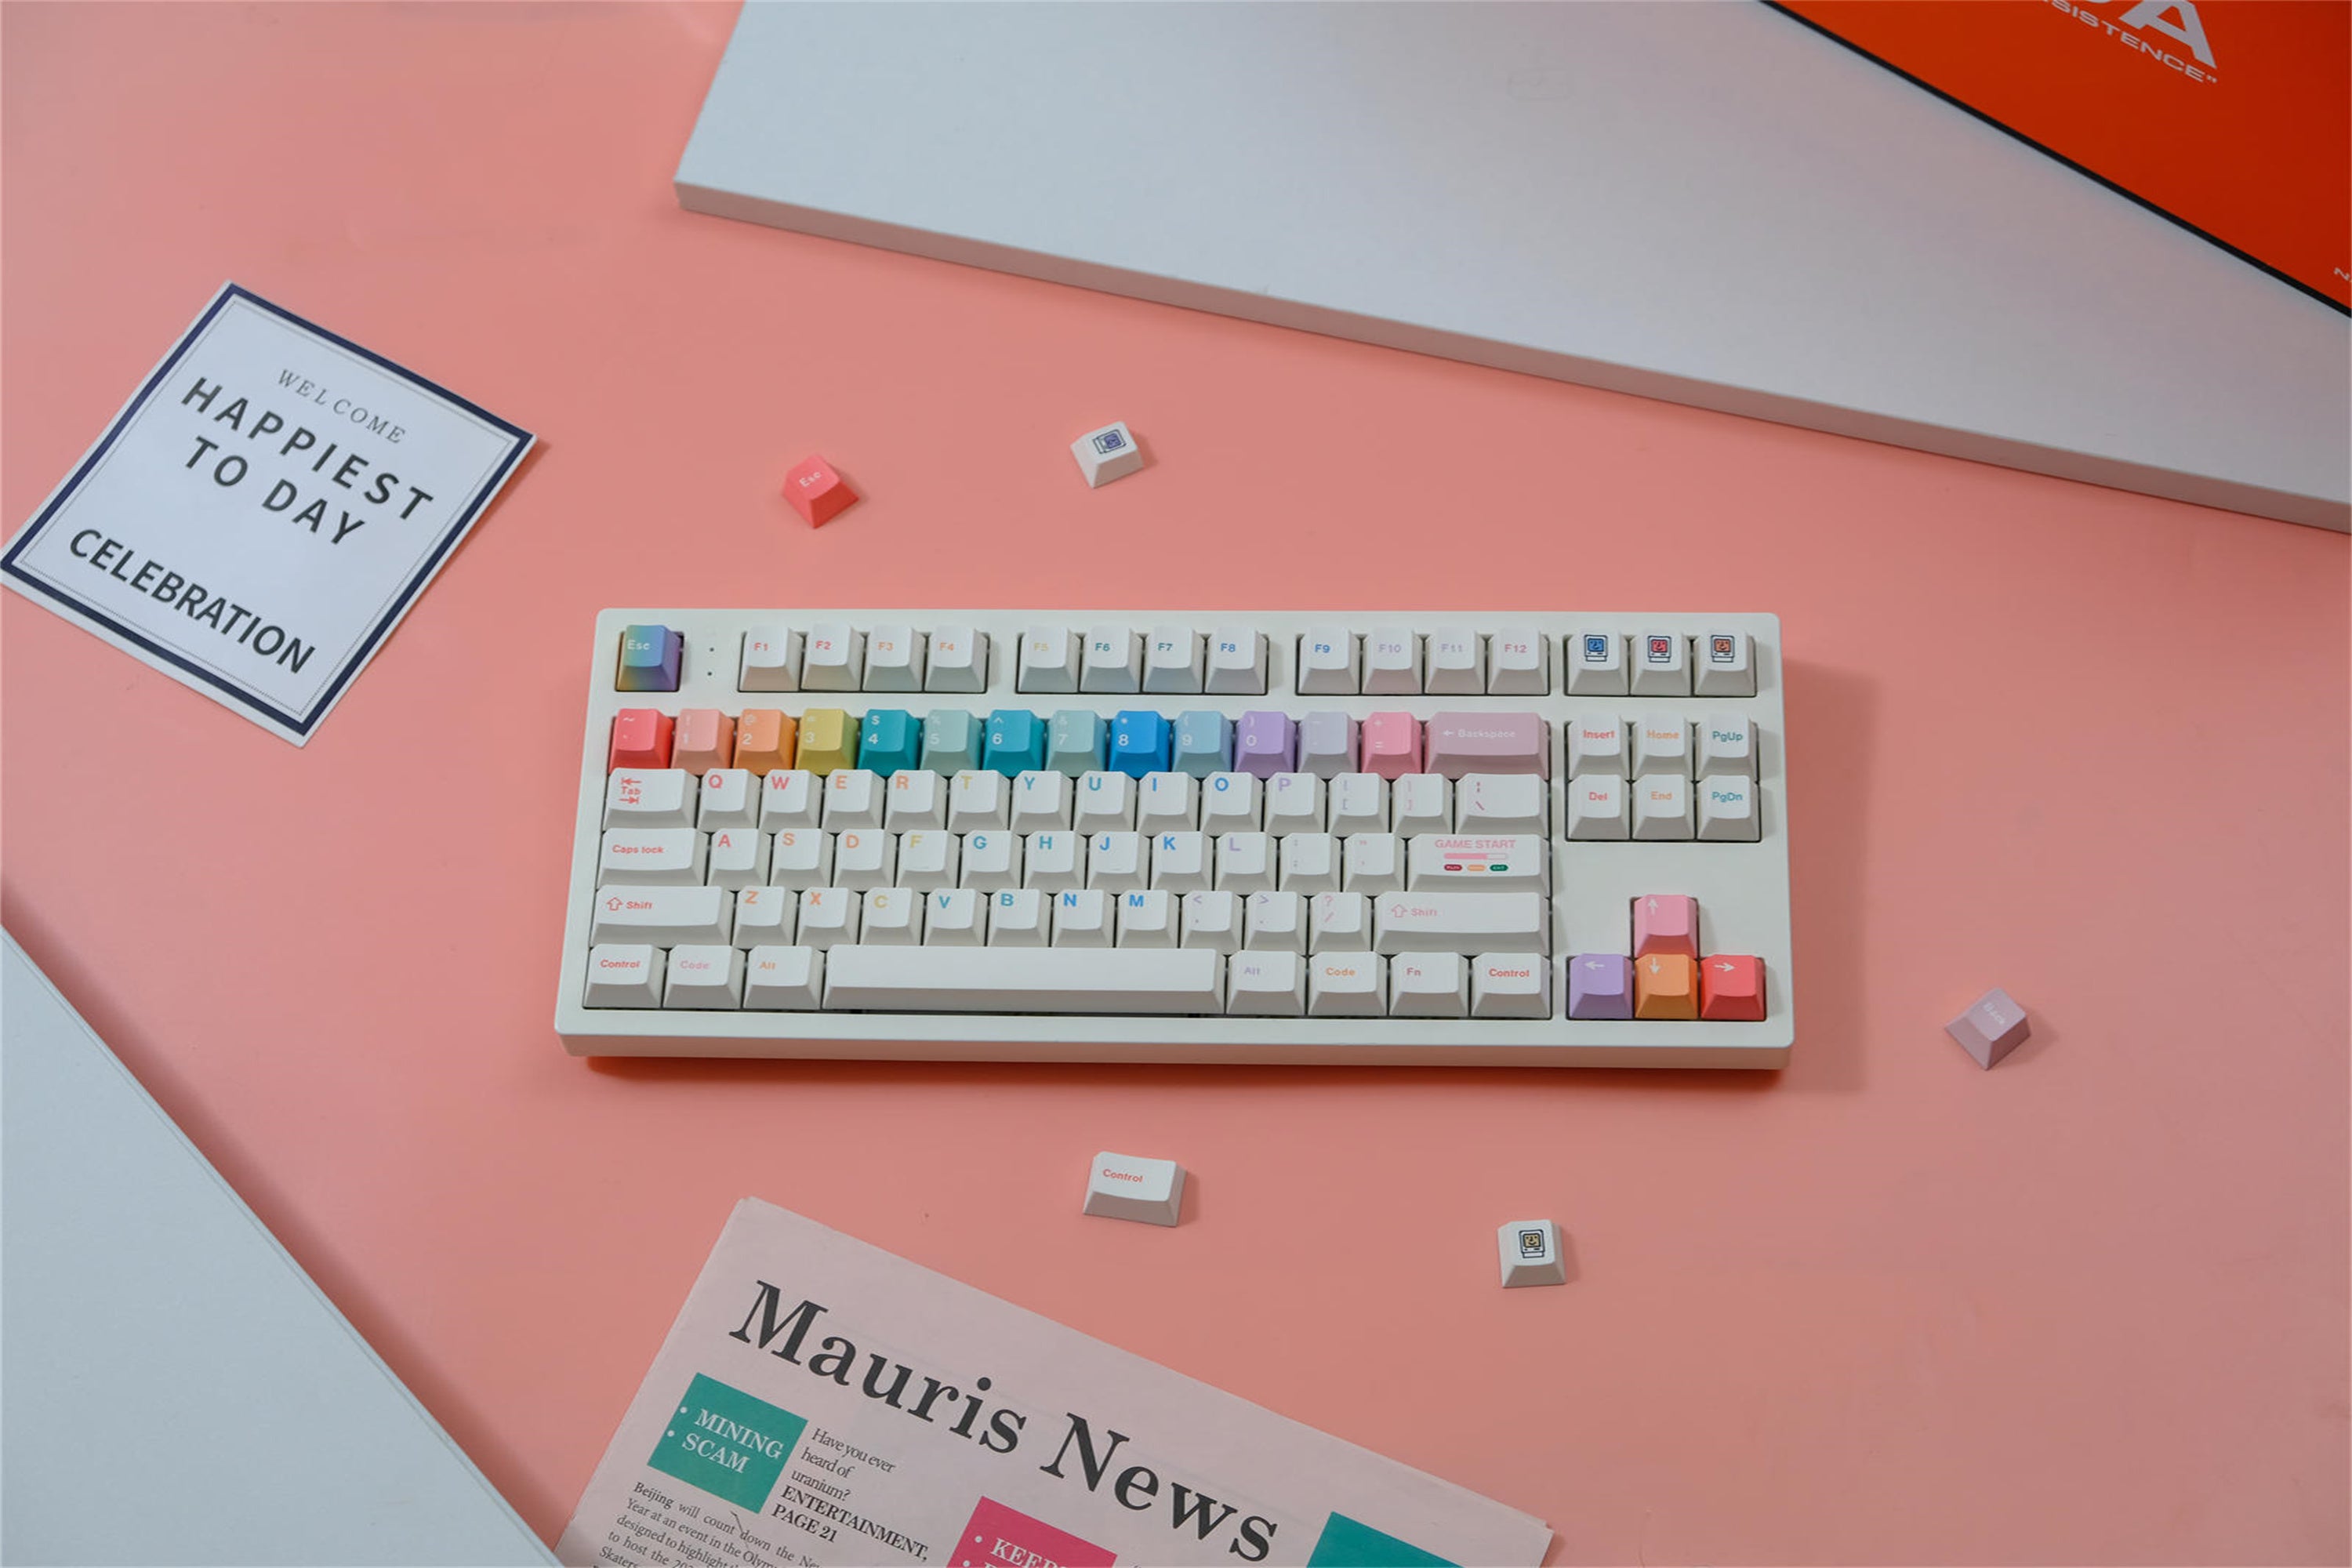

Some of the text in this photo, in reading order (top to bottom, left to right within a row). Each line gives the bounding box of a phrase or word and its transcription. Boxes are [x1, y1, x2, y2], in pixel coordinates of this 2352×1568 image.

[2082, 0, 2218, 69] A
[278, 368, 405, 444] WELCOME
[181, 376, 433, 520] HAPPIEST
[799, 472, 821, 488] Esc
[185, 436, 365, 545] TO DAY
[70, 528, 315, 673] CELEBRATION
[627, 640, 651, 651] Esc
[754, 642, 769, 652] F1
[815, 641, 831, 650] F2
[878, 641, 894, 652] F3
[939, 641, 954, 652] F4
[1033, 642, 1048, 652] F5
[1095, 642, 1110, 652] F6
[1158, 642, 1174, 652] F7
[1220, 643, 1236, 653] F8
[1315, 644, 1330, 654] F9
[1377, 643, 1402, 654] F10
[1441, 643, 1463, 654] F11
[1504, 643, 1527, 654] F12
[742, 733, 752, 745] 2
[805, 732, 815, 743] 3
[868, 733, 878, 744] 4
[930, 733, 939, 744] 5
[992, 734, 1003, 744] 6
[1058, 734, 1068, 746] 7
[1457, 728, 1515, 739] Backspace
[1583, 729, 1615, 739] Insert
[1647, 729, 1679, 739] Home
[1712, 730, 1743, 742] PgUp
[1118, 735, 1129, 746] 8
[1182, 735, 1192, 746] 9
[1247, 735, 1258, 746] 0
[709, 775, 723, 789] Q
[771, 776, 789, 789] W
[836, 776, 847, 789] E
[896, 776, 909, 789] R
[960, 775, 972, 789] T
[1025, 776, 1036, 790] Y
[1089, 777, 1102, 791] U
[1214, 777, 1229, 791] O
[1278, 778, 1291, 791] P
[621, 785, 641, 795] Tab
[1588, 791, 1607, 800] Del
[1650, 791, 1672, 800] End
[1711, 791, 1743, 804] PgDn
[718, 834, 731, 848] A
[782, 833, 795, 847] S
[846, 834, 859, 848] D
[910, 835, 922, 848] F
[973, 836, 987, 850] G
[1039, 836, 1052, 850] H
[1099, 837, 1110, 851] J
[1163, 837, 1176, 850] K
[1229, 838, 1240, 851] L
[1434, 839, 1516, 849] GAME START
[612, 844, 664, 856] Caps lock
[745, 891, 759, 904] Z
[810, 891, 822, 906] X
[874, 895, 887, 909] C
[938, 895, 951, 909] V
[1000, 893, 1014, 906] B
[1063, 894, 1077, 907] N
[1129, 895, 1144, 907] M
[626, 900, 652, 910] Shift
[1410, 908, 1438, 917] Shift
[600, 959, 640, 969] Control
[680, 959, 710, 971] Code
[759, 961, 776, 971] Alt
[1244, 966, 1261, 975] Alt
[1326, 966, 1356, 977] Code
[1406, 967, 1421, 977] Fn
[1490, 967, 1530, 978] Control
[1103, 1168, 1143, 1182] Control
[729, 1279, 1279, 1562] Mauris News
[695, 1409, 783, 1460] MINING
[681, 1432, 750, 1473] SCAM
[811, 1428, 895, 1473] Have you ever
[800, 1447, 855, 1479] heard of
[791, 1469, 851, 1501] uranium?
[626, 1497, 650, 1516] Year
[650, 1511, 662, 1522] at
[662, 1517, 677, 1529] an
[678, 1524, 709, 1542] event
[709, 1534, 722, 1548] in
[722, 1537, 742, 1557] the
[633, 1482, 674, 1509] Beijing
[678, 1502, 700, 1519] will
[702, 1515, 736, 1534] count
[740, 1530, 771, 1551] down
[776, 1544, 795, 1562] the
[771, 1503, 838, 1543] PAGE 21
[781, 1485, 929, 1561] ENTERTAINMENT,
[616, 1515, 666, 1543] designed
[666, 1535, 677, 1548] to
[608, 1531, 619, 1543] to
[622, 1535, 648, 1555] host
[651, 1548, 670, 1565] the
